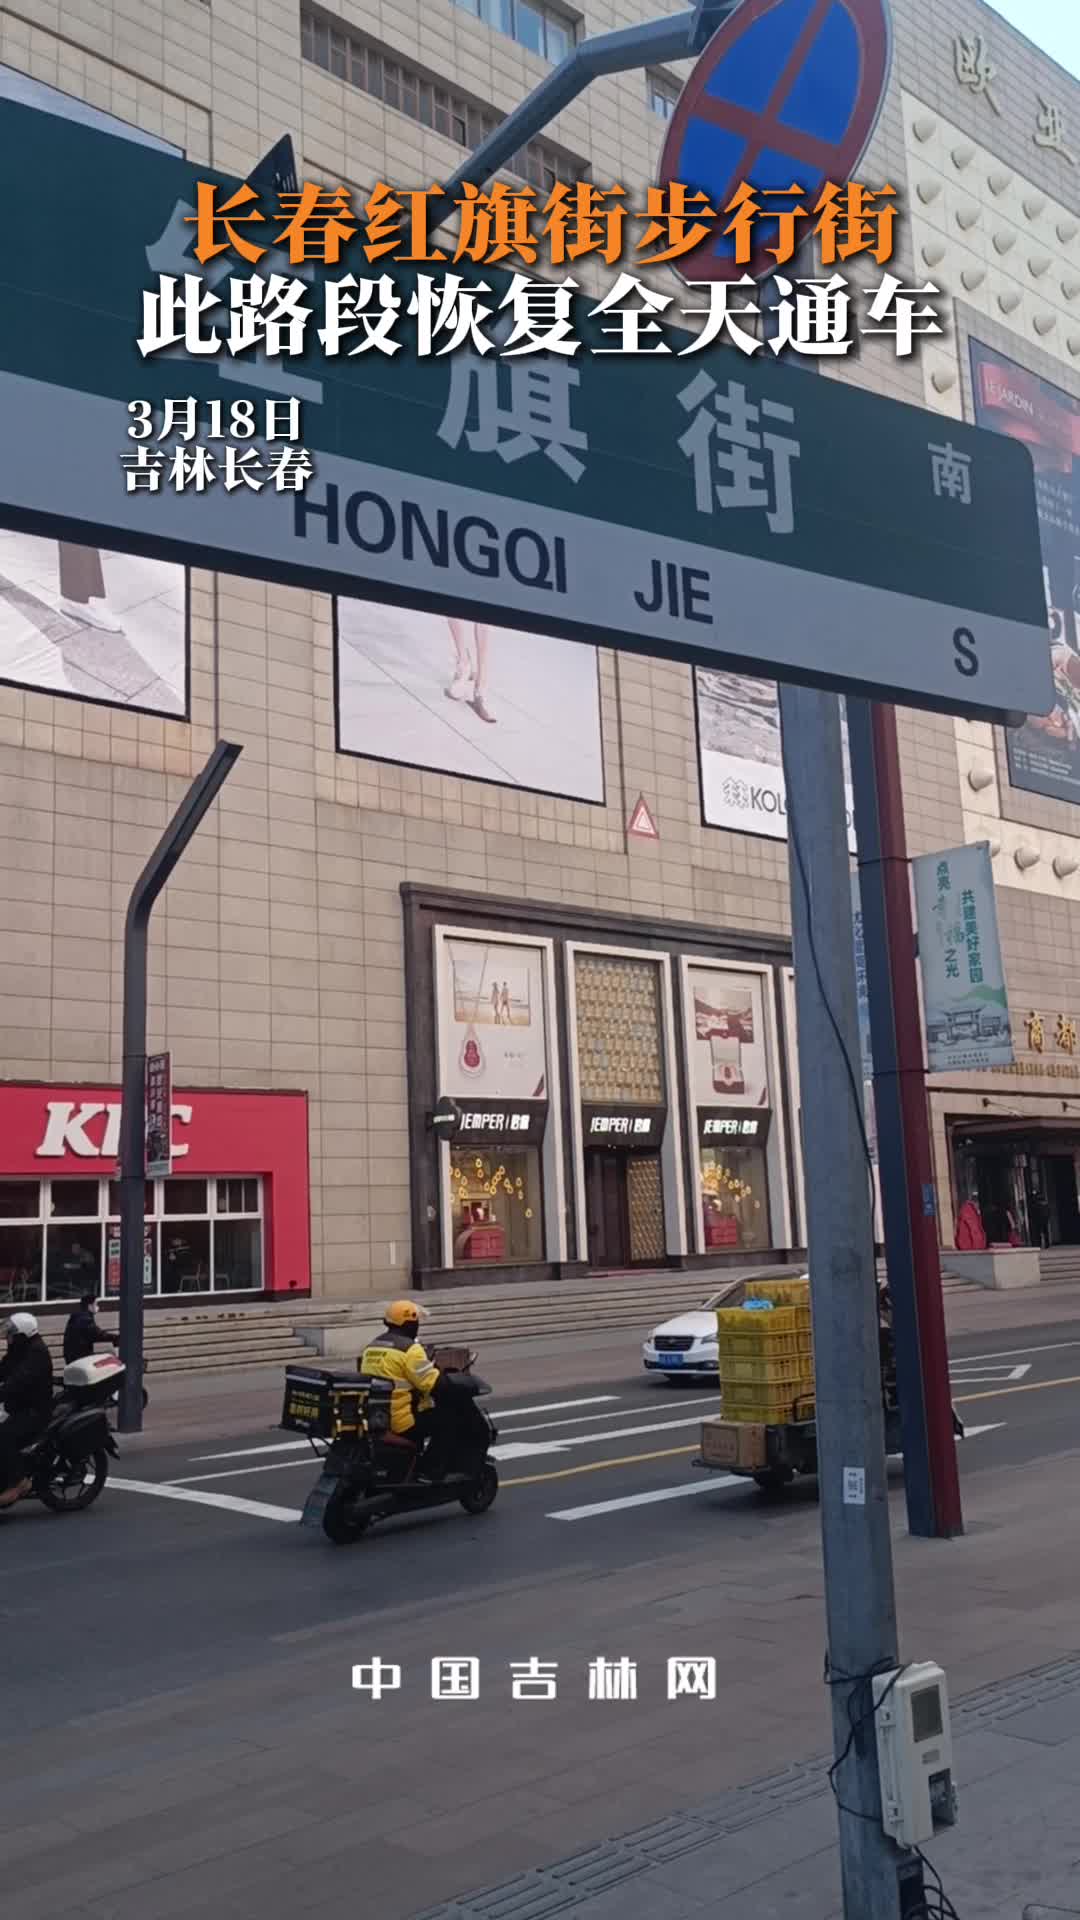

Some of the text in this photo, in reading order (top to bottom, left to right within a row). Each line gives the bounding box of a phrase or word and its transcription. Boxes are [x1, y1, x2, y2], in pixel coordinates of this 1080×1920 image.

[927, 442, 972, 505] 南
[293, 484, 714, 625] HONGQI JIE
[953, 627, 979, 677] S
[961, 889, 984, 984] 共建美好家园
[459, 1112, 504, 1132] JEMPER
